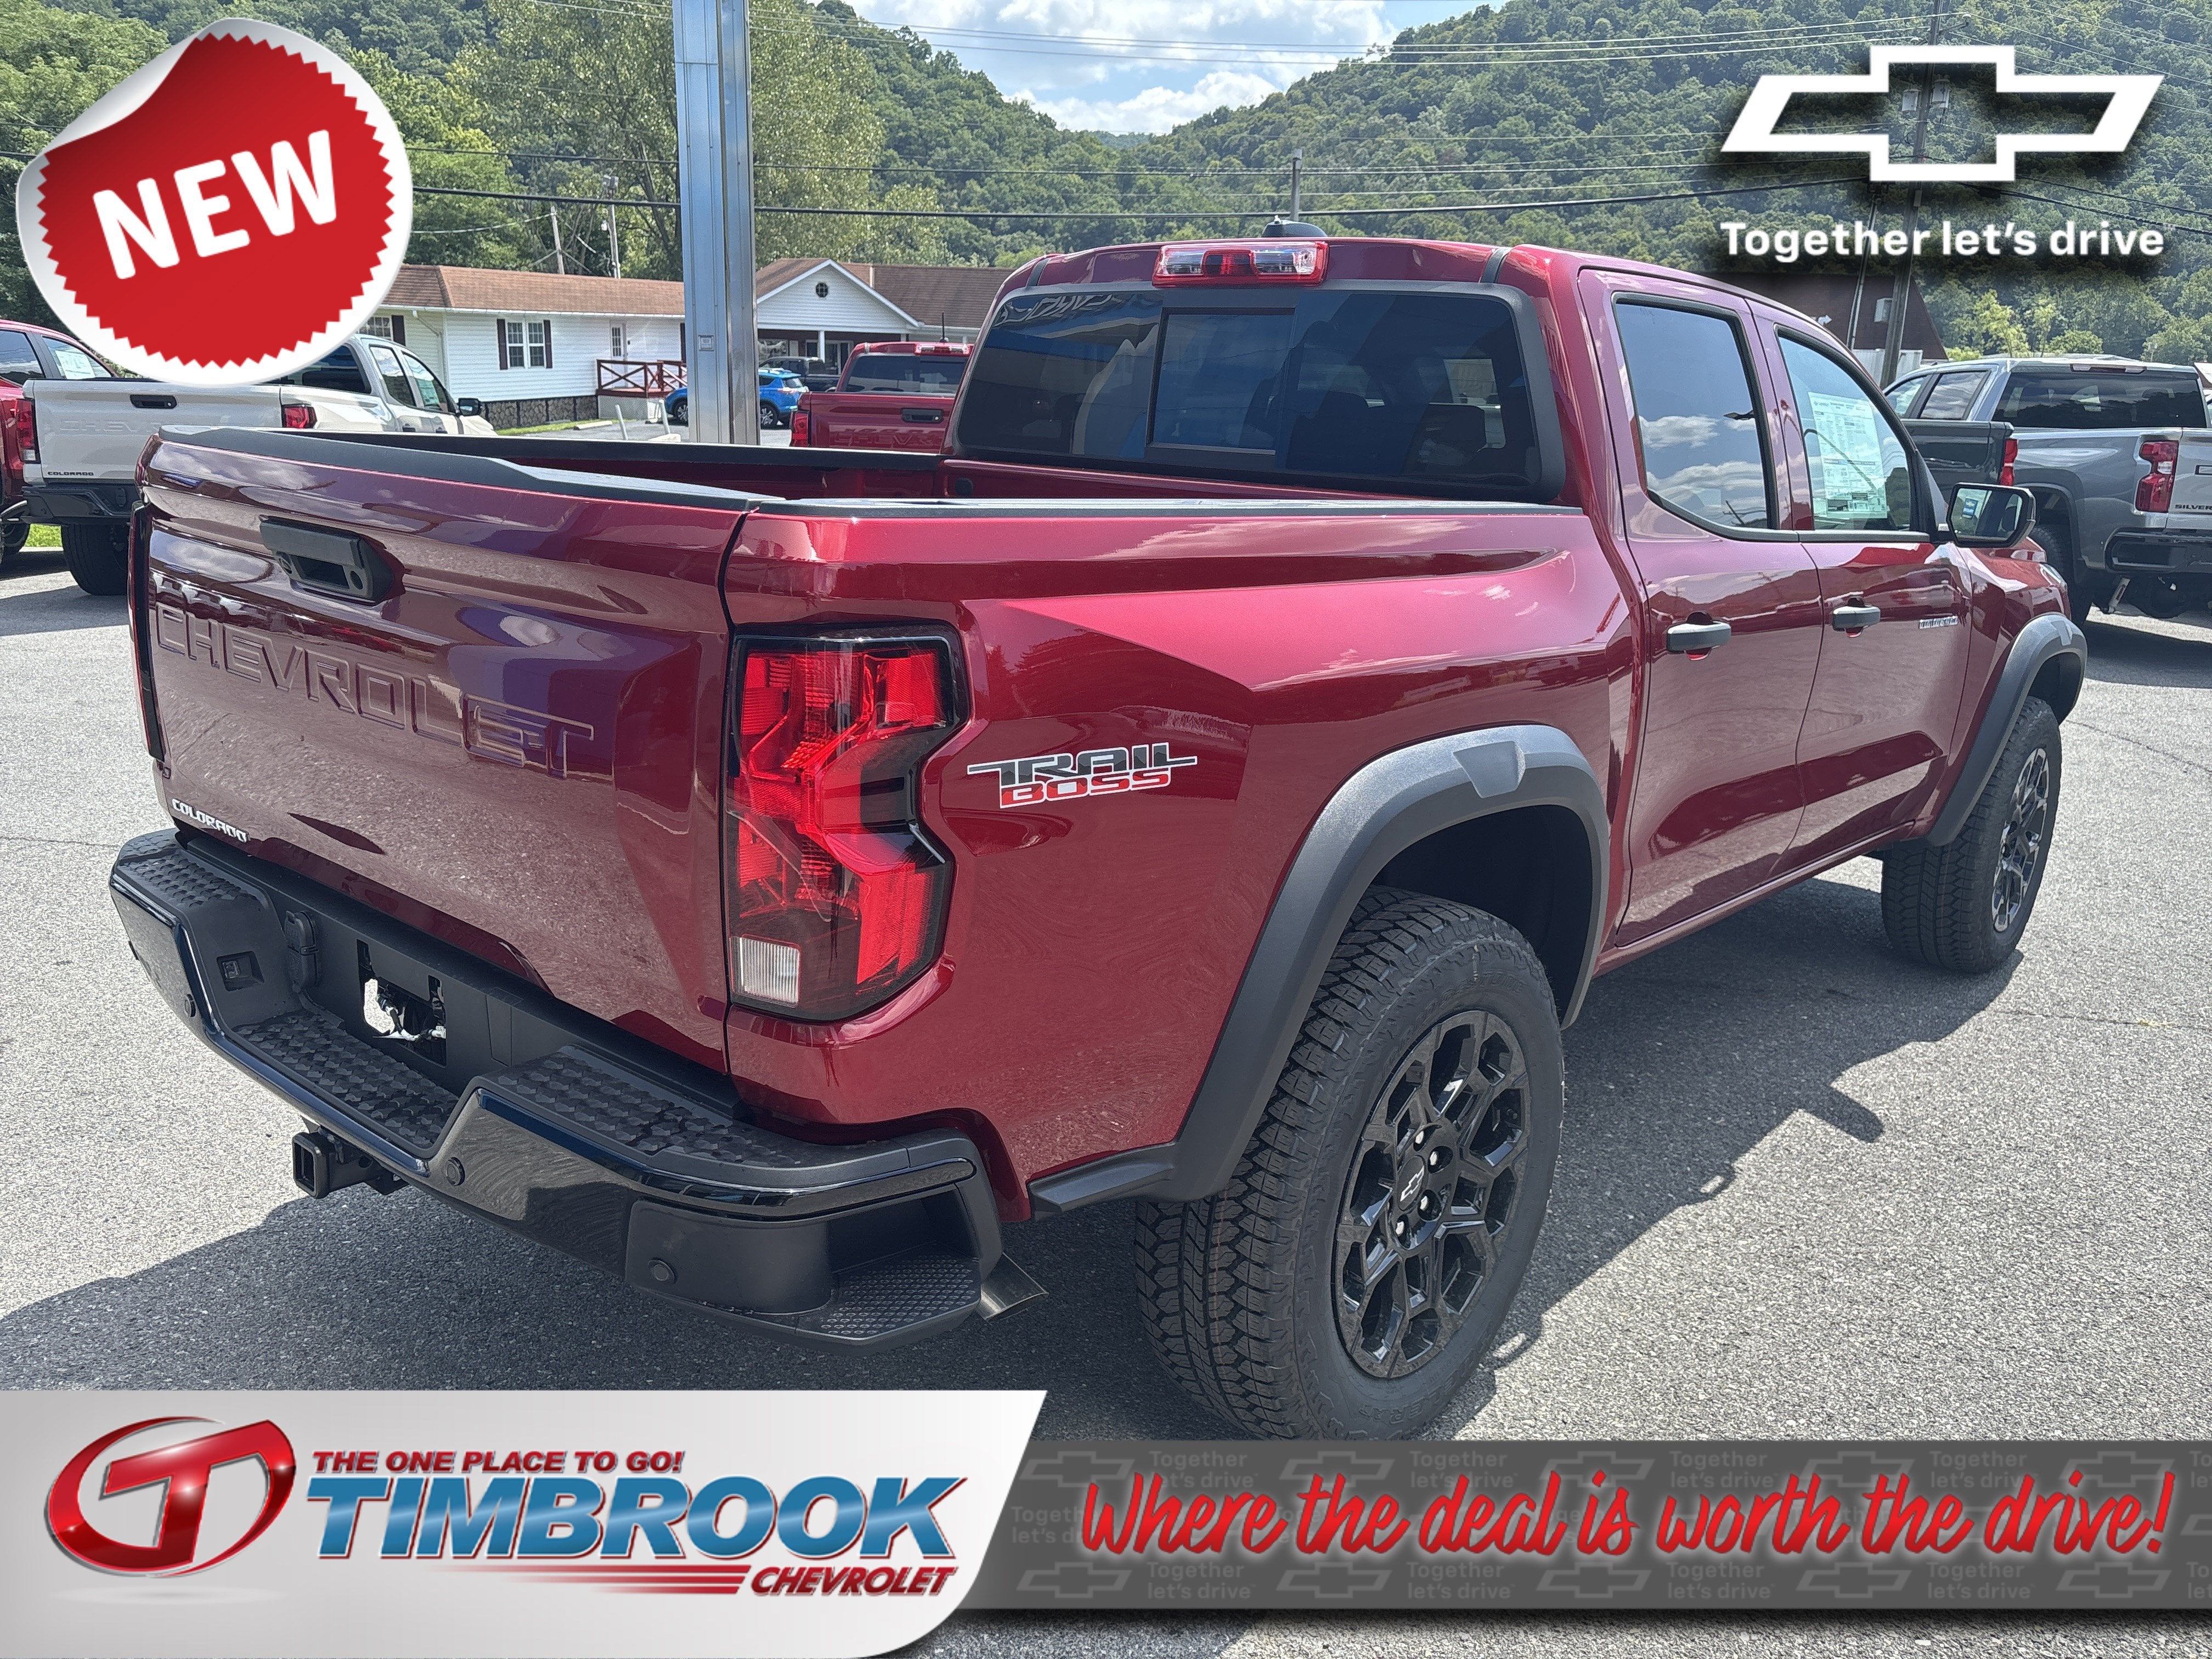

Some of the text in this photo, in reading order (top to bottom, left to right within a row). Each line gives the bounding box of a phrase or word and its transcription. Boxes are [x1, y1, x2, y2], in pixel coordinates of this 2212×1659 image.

[156, 601, 596, 779] CHEVROLET
[967, 742, 1198, 787] TRAIL
[1000, 768, 1172, 809] BOSS
[172, 798, 250, 843] COLORADO
